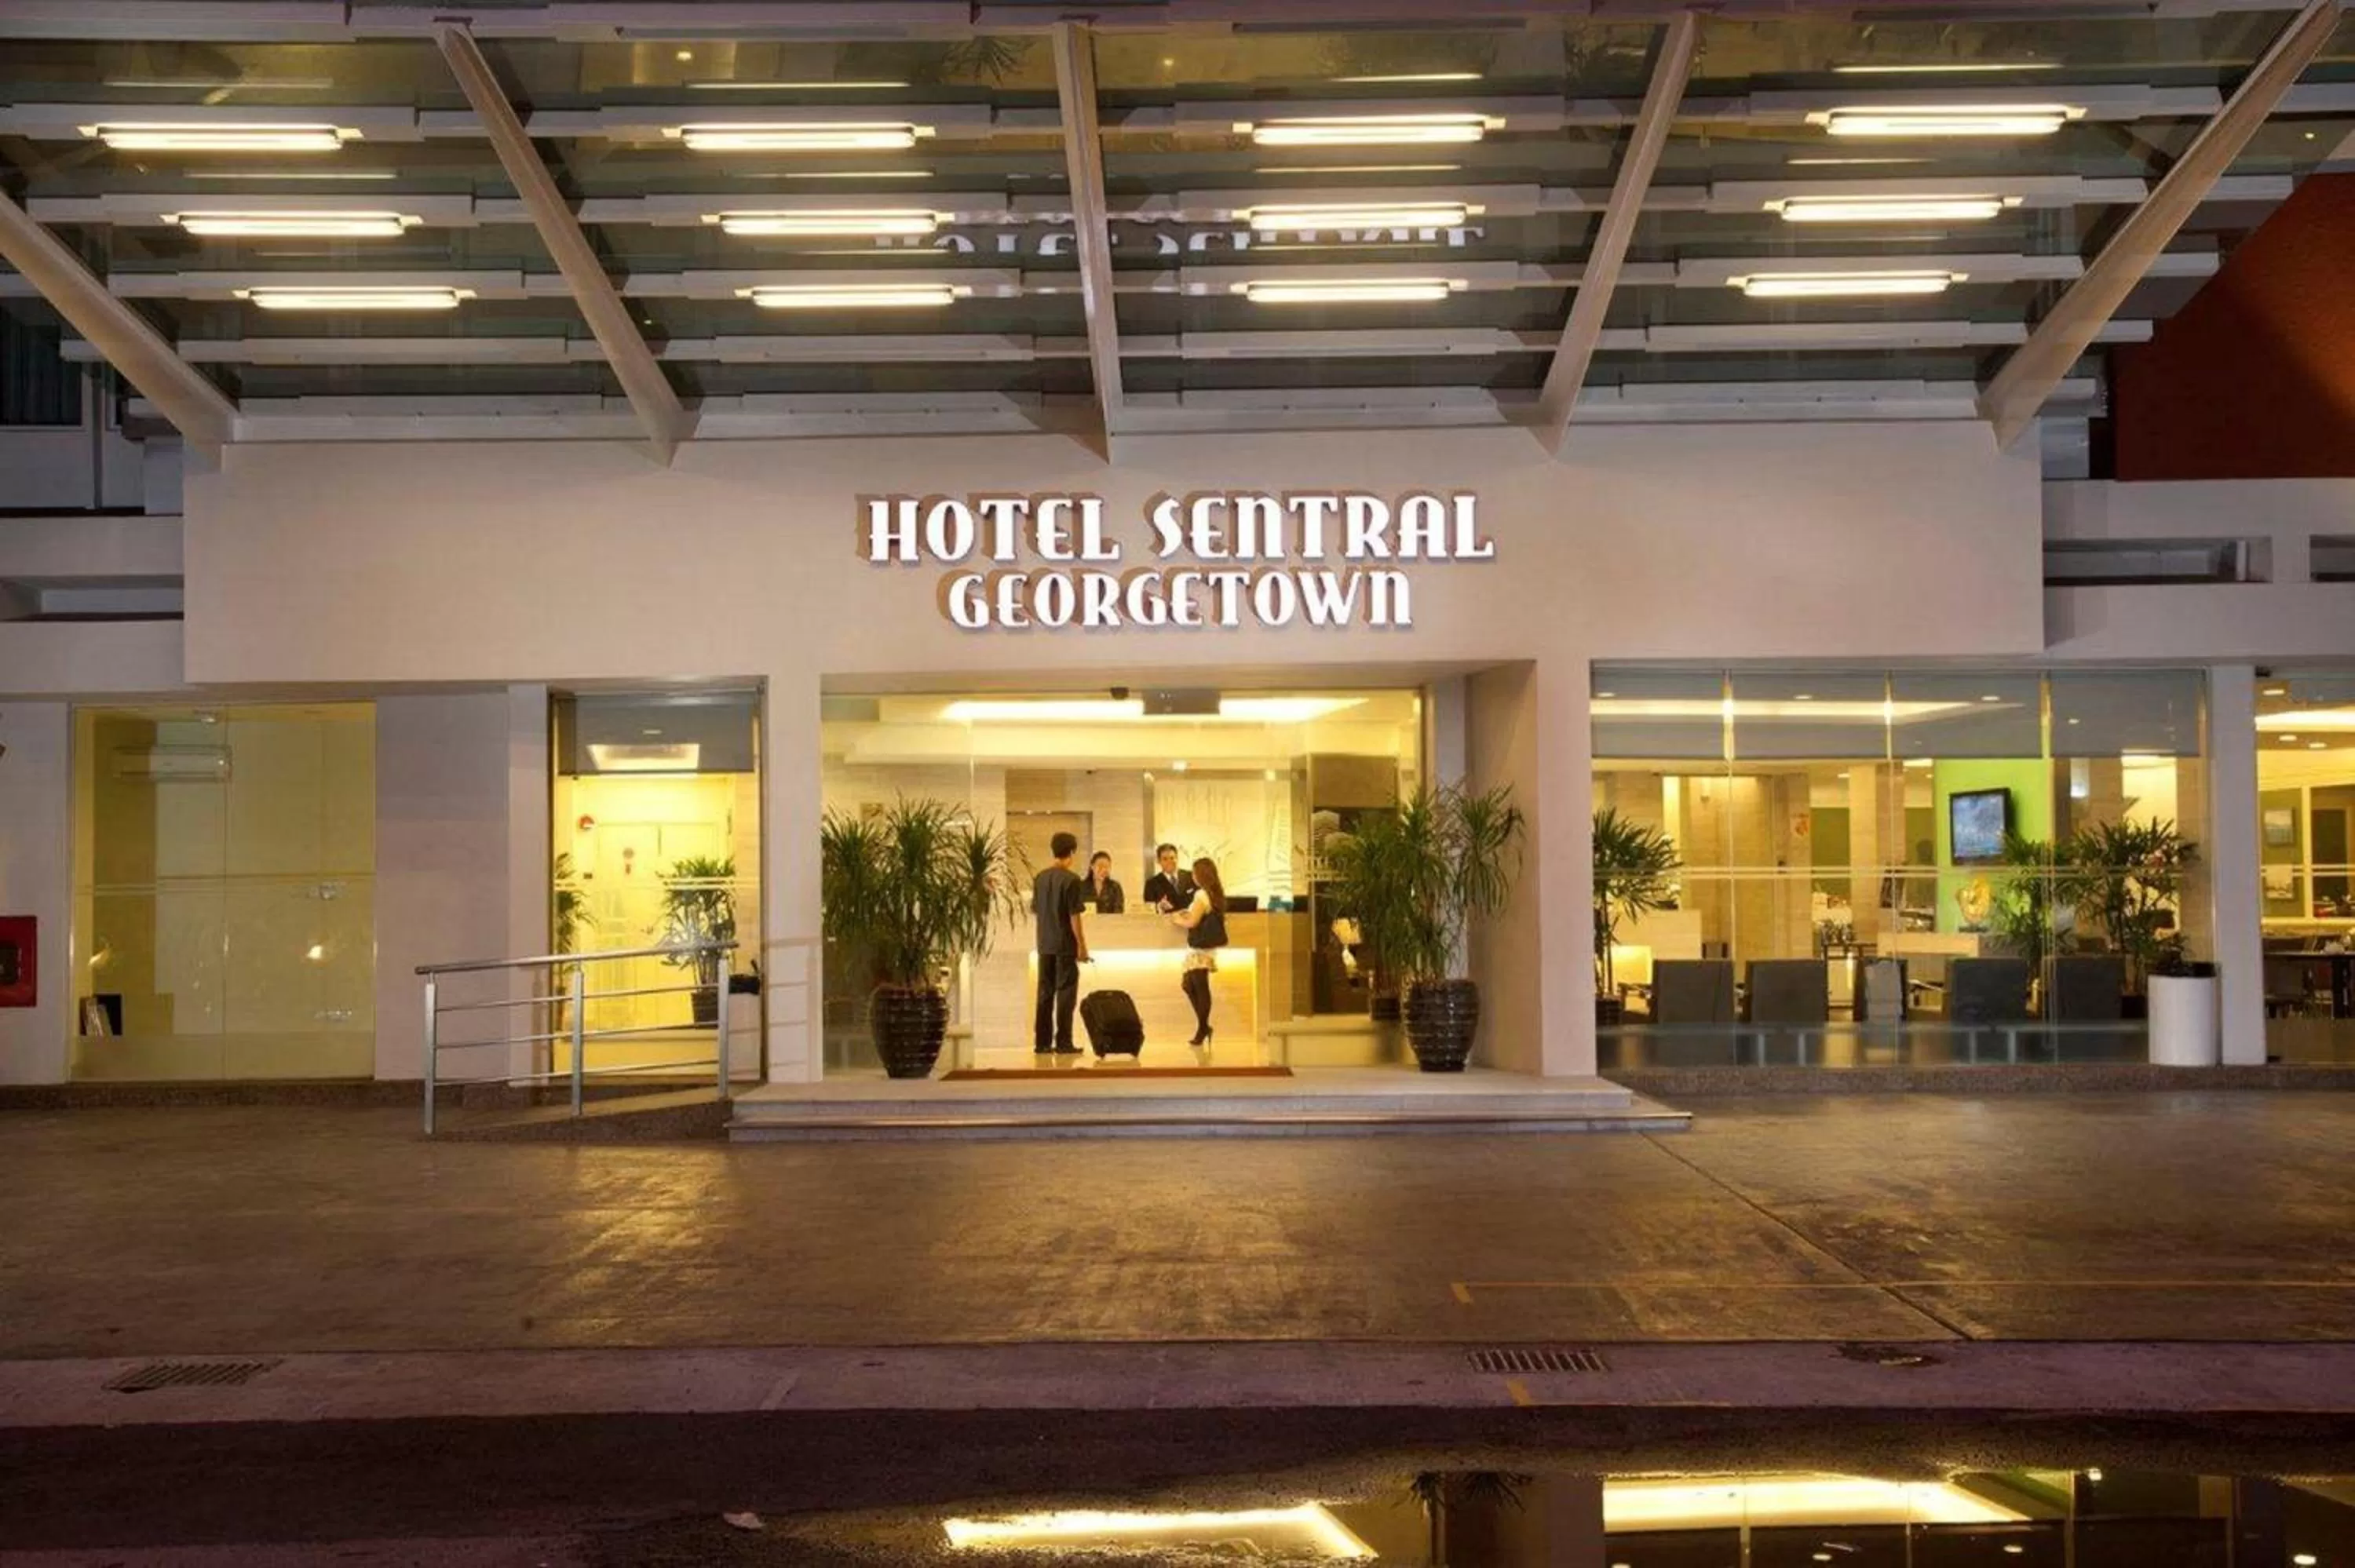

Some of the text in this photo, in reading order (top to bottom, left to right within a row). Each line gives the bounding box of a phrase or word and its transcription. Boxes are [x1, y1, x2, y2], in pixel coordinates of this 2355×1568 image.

[867, 495, 1495, 561] HOTEL SENTRAL
[947, 571, 1413, 628] GEORGETOWN
